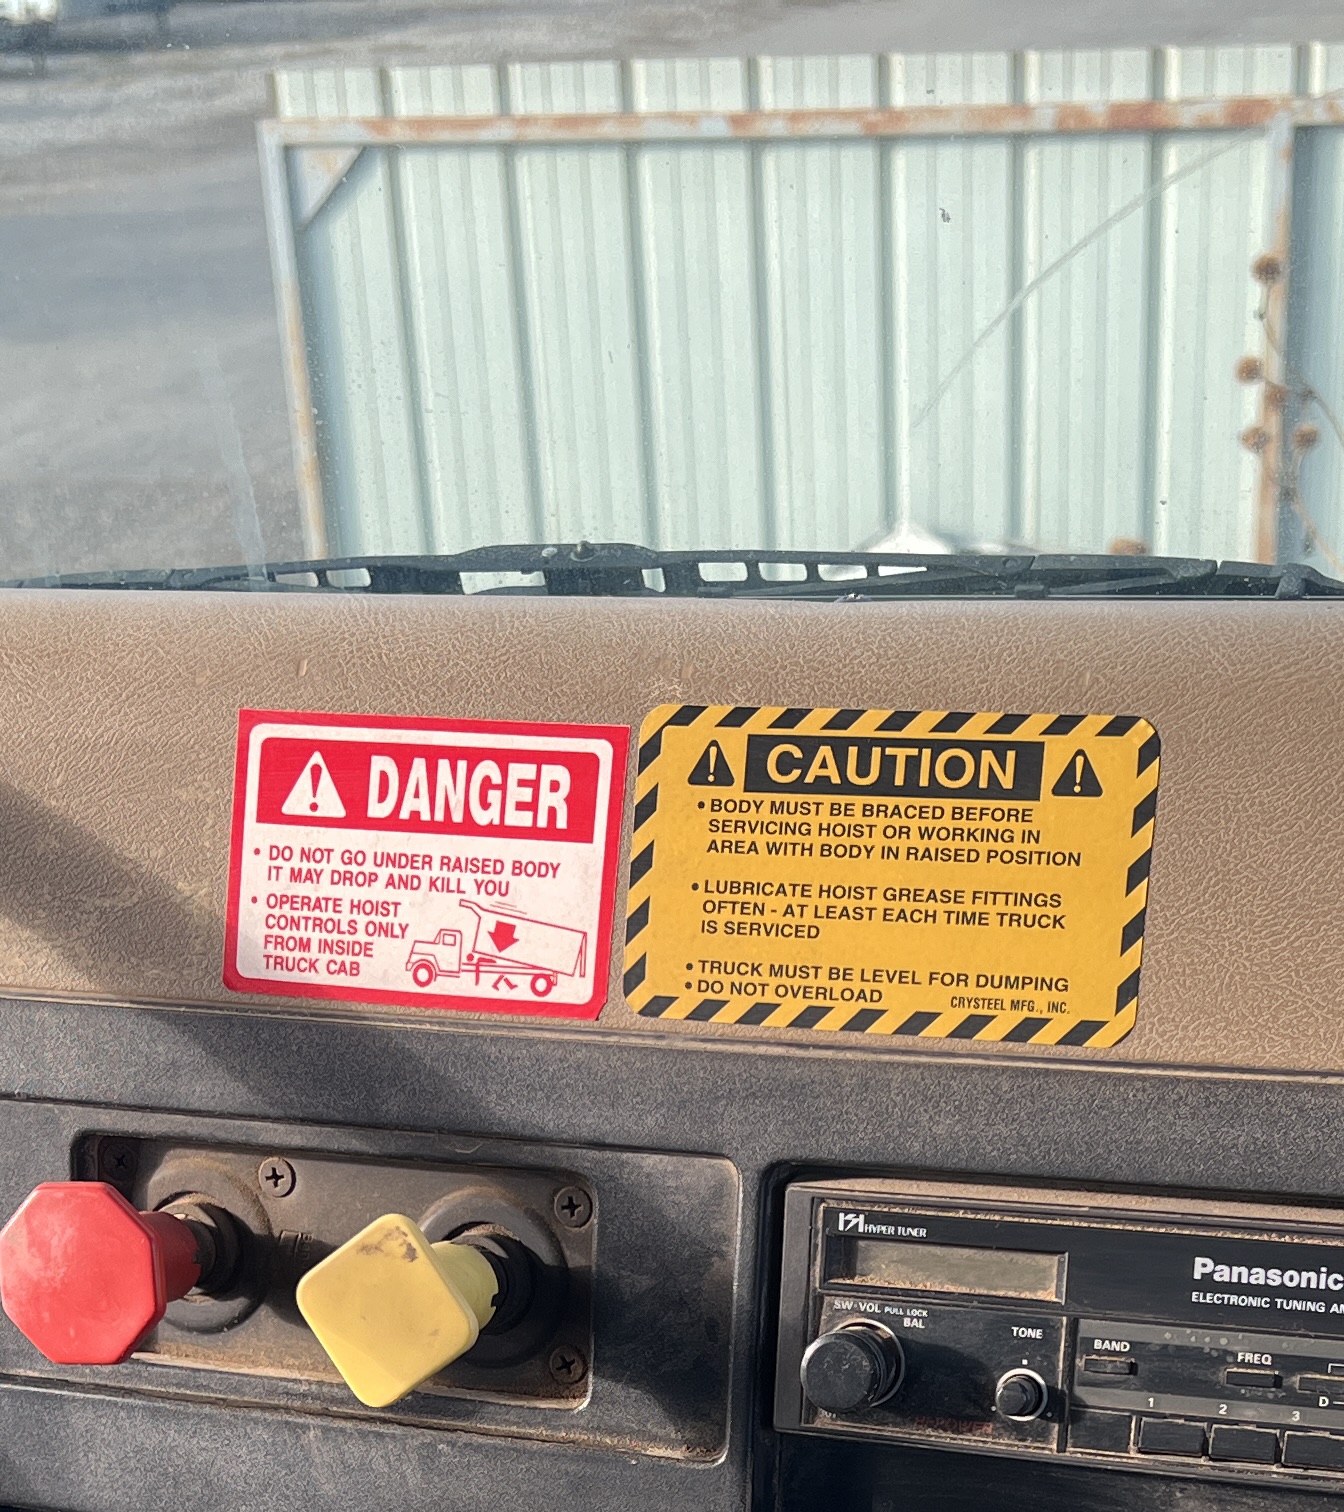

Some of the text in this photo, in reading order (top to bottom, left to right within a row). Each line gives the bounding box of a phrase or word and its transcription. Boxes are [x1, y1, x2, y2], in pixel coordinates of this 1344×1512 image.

[766, 743, 1016, 789] CAUTION
[367, 755, 570, 829] DANGER
[710, 798, 1033, 823] BODY MUST BE BRACED BEFORE
[708, 818, 1040, 844] SERVICING HOIST OR WORKING IN
[269, 844, 561, 878] DO NOT GO UNDER RAISED BODY
[706, 839, 1081, 866] AREA WITH BODY IN RAISED POSITION
[267, 865, 509, 897] IT MAY DROP AND KILL YOU
[266, 892, 401, 917] OPERATE HOIST
[704, 879, 1062, 908] LUBRICATE HOIST GREASE FITTINGS
[265, 913, 409, 939] CONTROLS ONLY
[701, 919, 820, 939] IS SERVICED
[263, 934, 373, 957] FROM INSIDE
[262, 954, 360, 977] TRUCK CAB
[697, 959, 1068, 992] TRUCK MUST BE LEVEL FOR DUMPING
[697, 979, 882, 1003] DO NOT OVERLOAD
[950, 996, 1006, 1011] CRYSTEEL
[864, 1223, 927, 1237] HYPER TUNER
[1193, 1257, 1344, 1291] Panasonic
[884, 1306, 928, 1317] PULL LOCK
[1191, 1291, 1270, 1308] ELECTRONIC
[1274, 1298, 1325, 1312] TUNING
[903, 1317, 925, 1328] BAL
[1011, 1326, 1043, 1339] TONE
[1093, 1338, 1130, 1352] BAND
[1237, 1351, 1272, 1365] FREQ
[1148, 1397, 1154, 1407] 1
[1218, 1403, 1227, 1415] 2
[1318, 1396, 1329, 1407] D
[1291, 1410, 1300, 1422] 3
